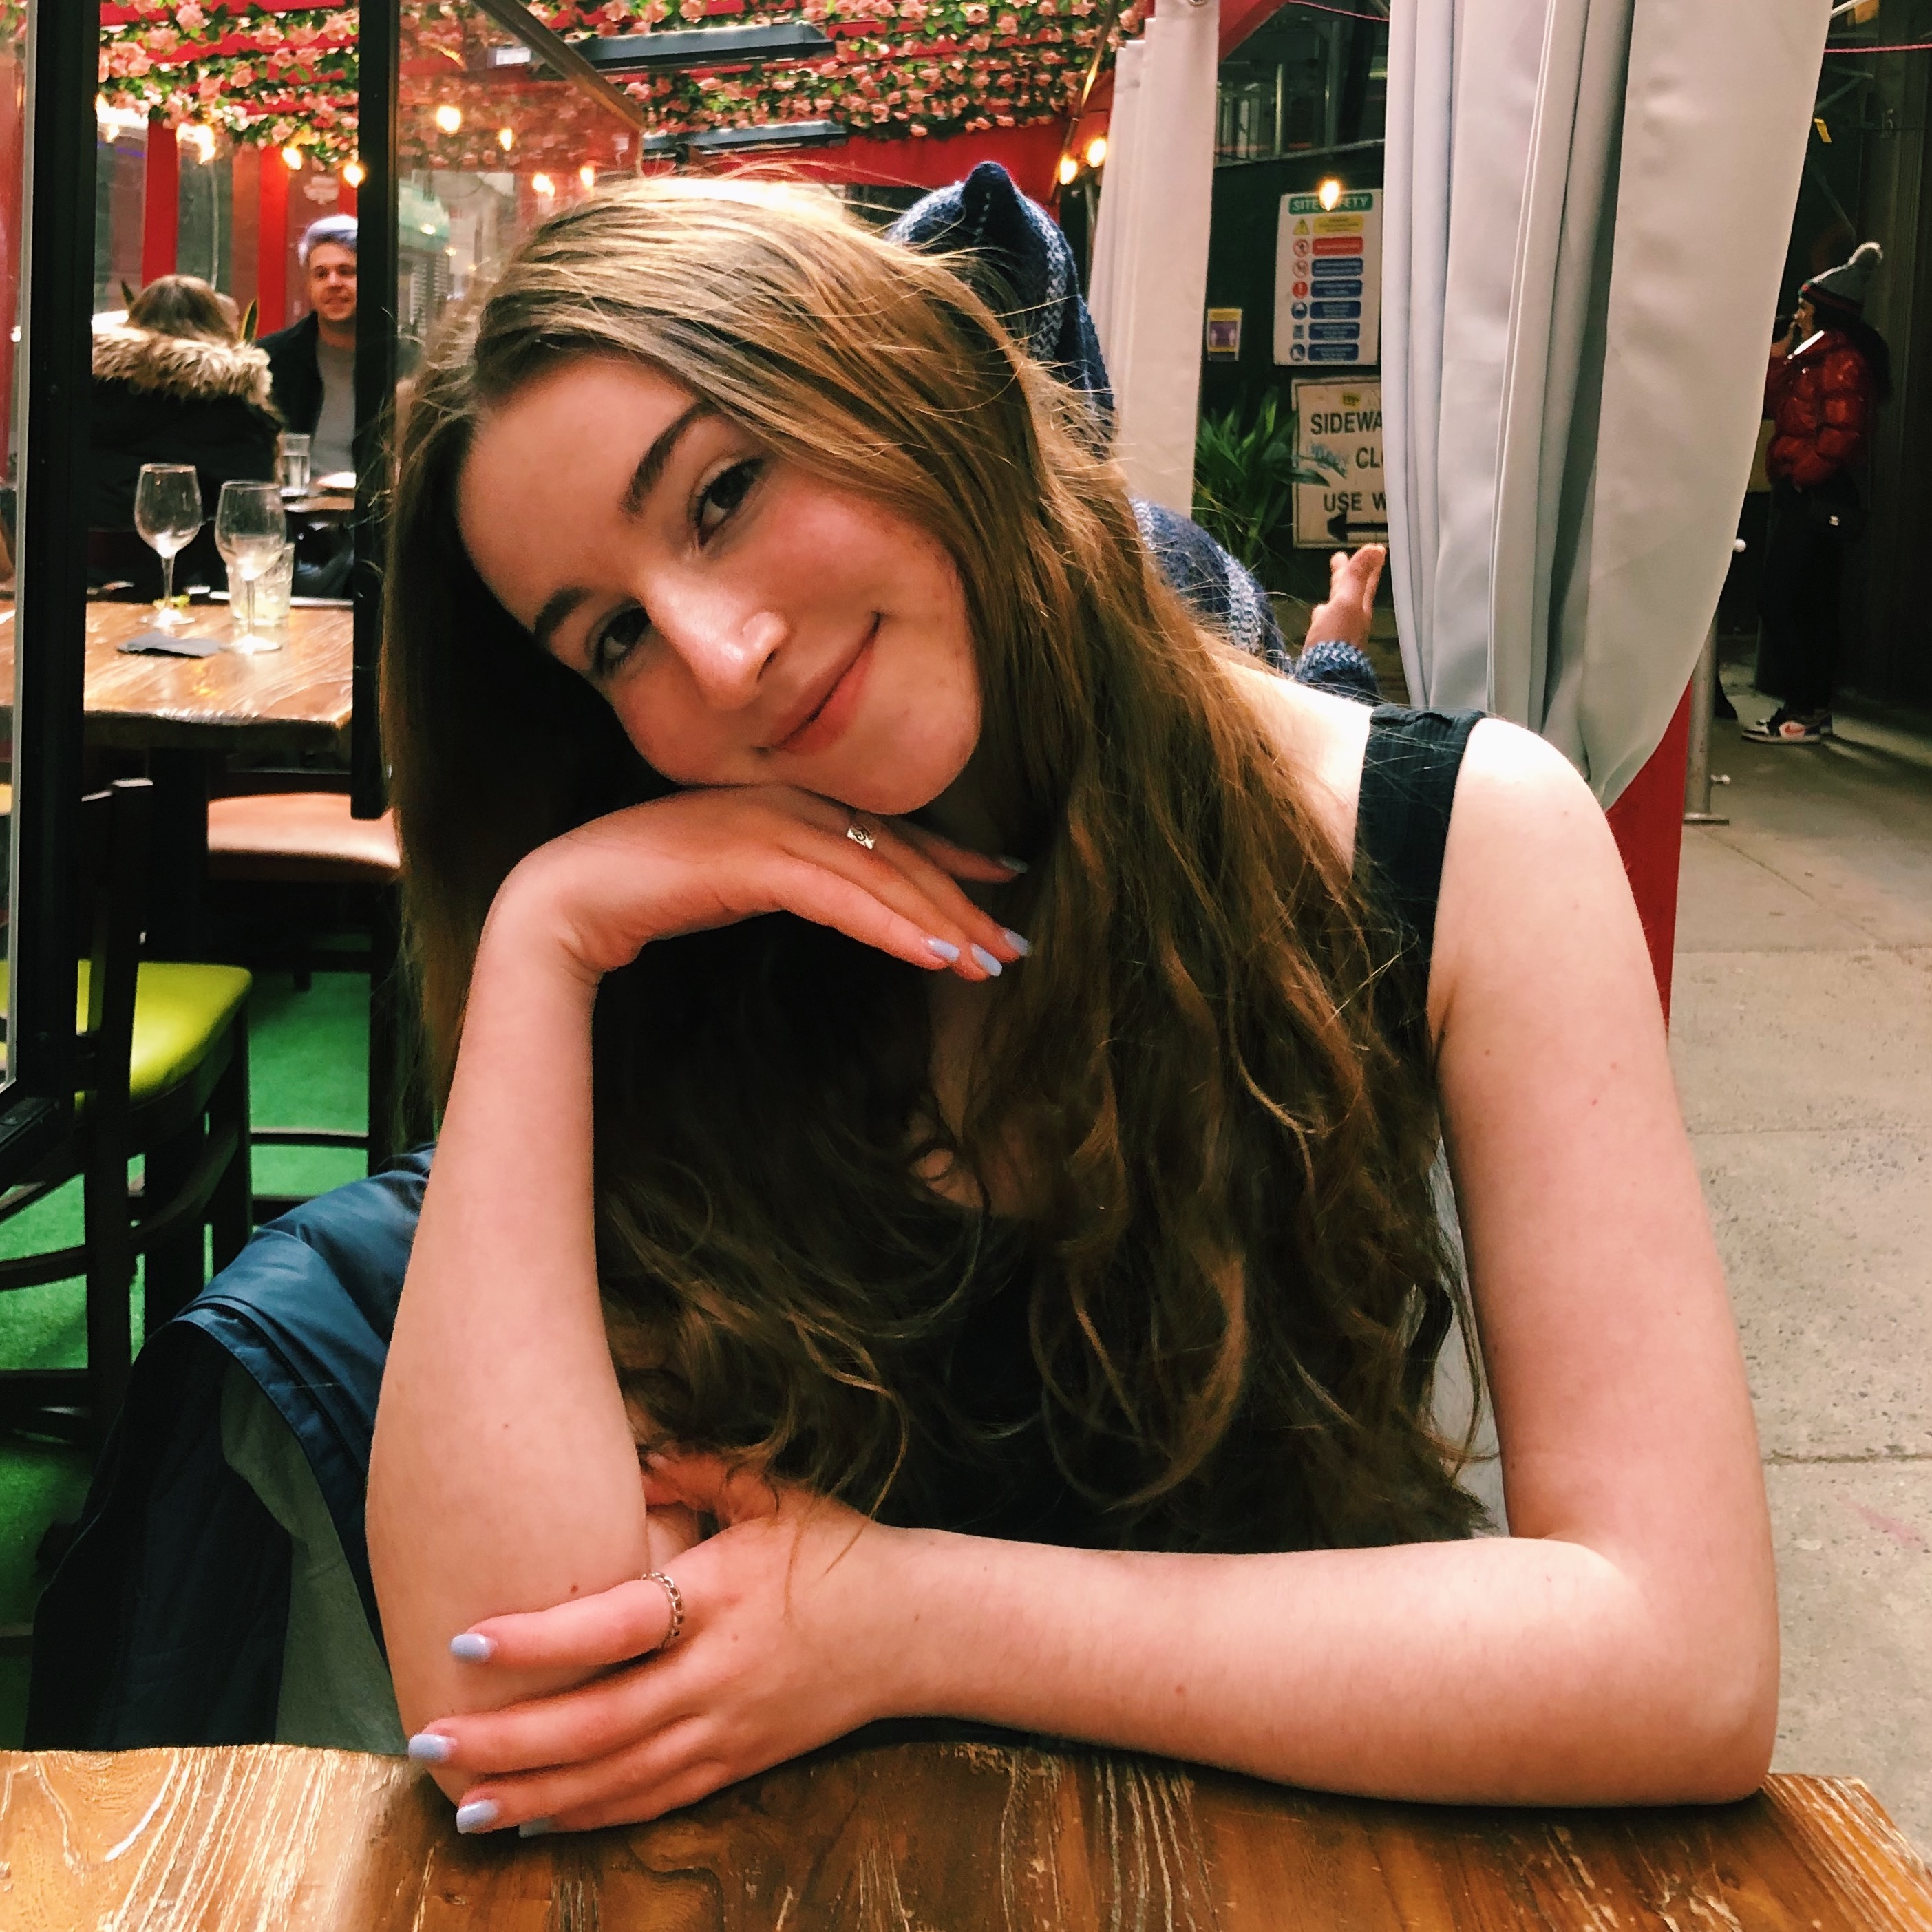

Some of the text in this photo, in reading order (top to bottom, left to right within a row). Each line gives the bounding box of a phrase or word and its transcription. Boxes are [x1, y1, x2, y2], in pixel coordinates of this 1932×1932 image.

[1293, 198, 1319, 211] SITE
[1355, 447, 1383, 469] CL
[1324, 491, 1362, 512] USE
